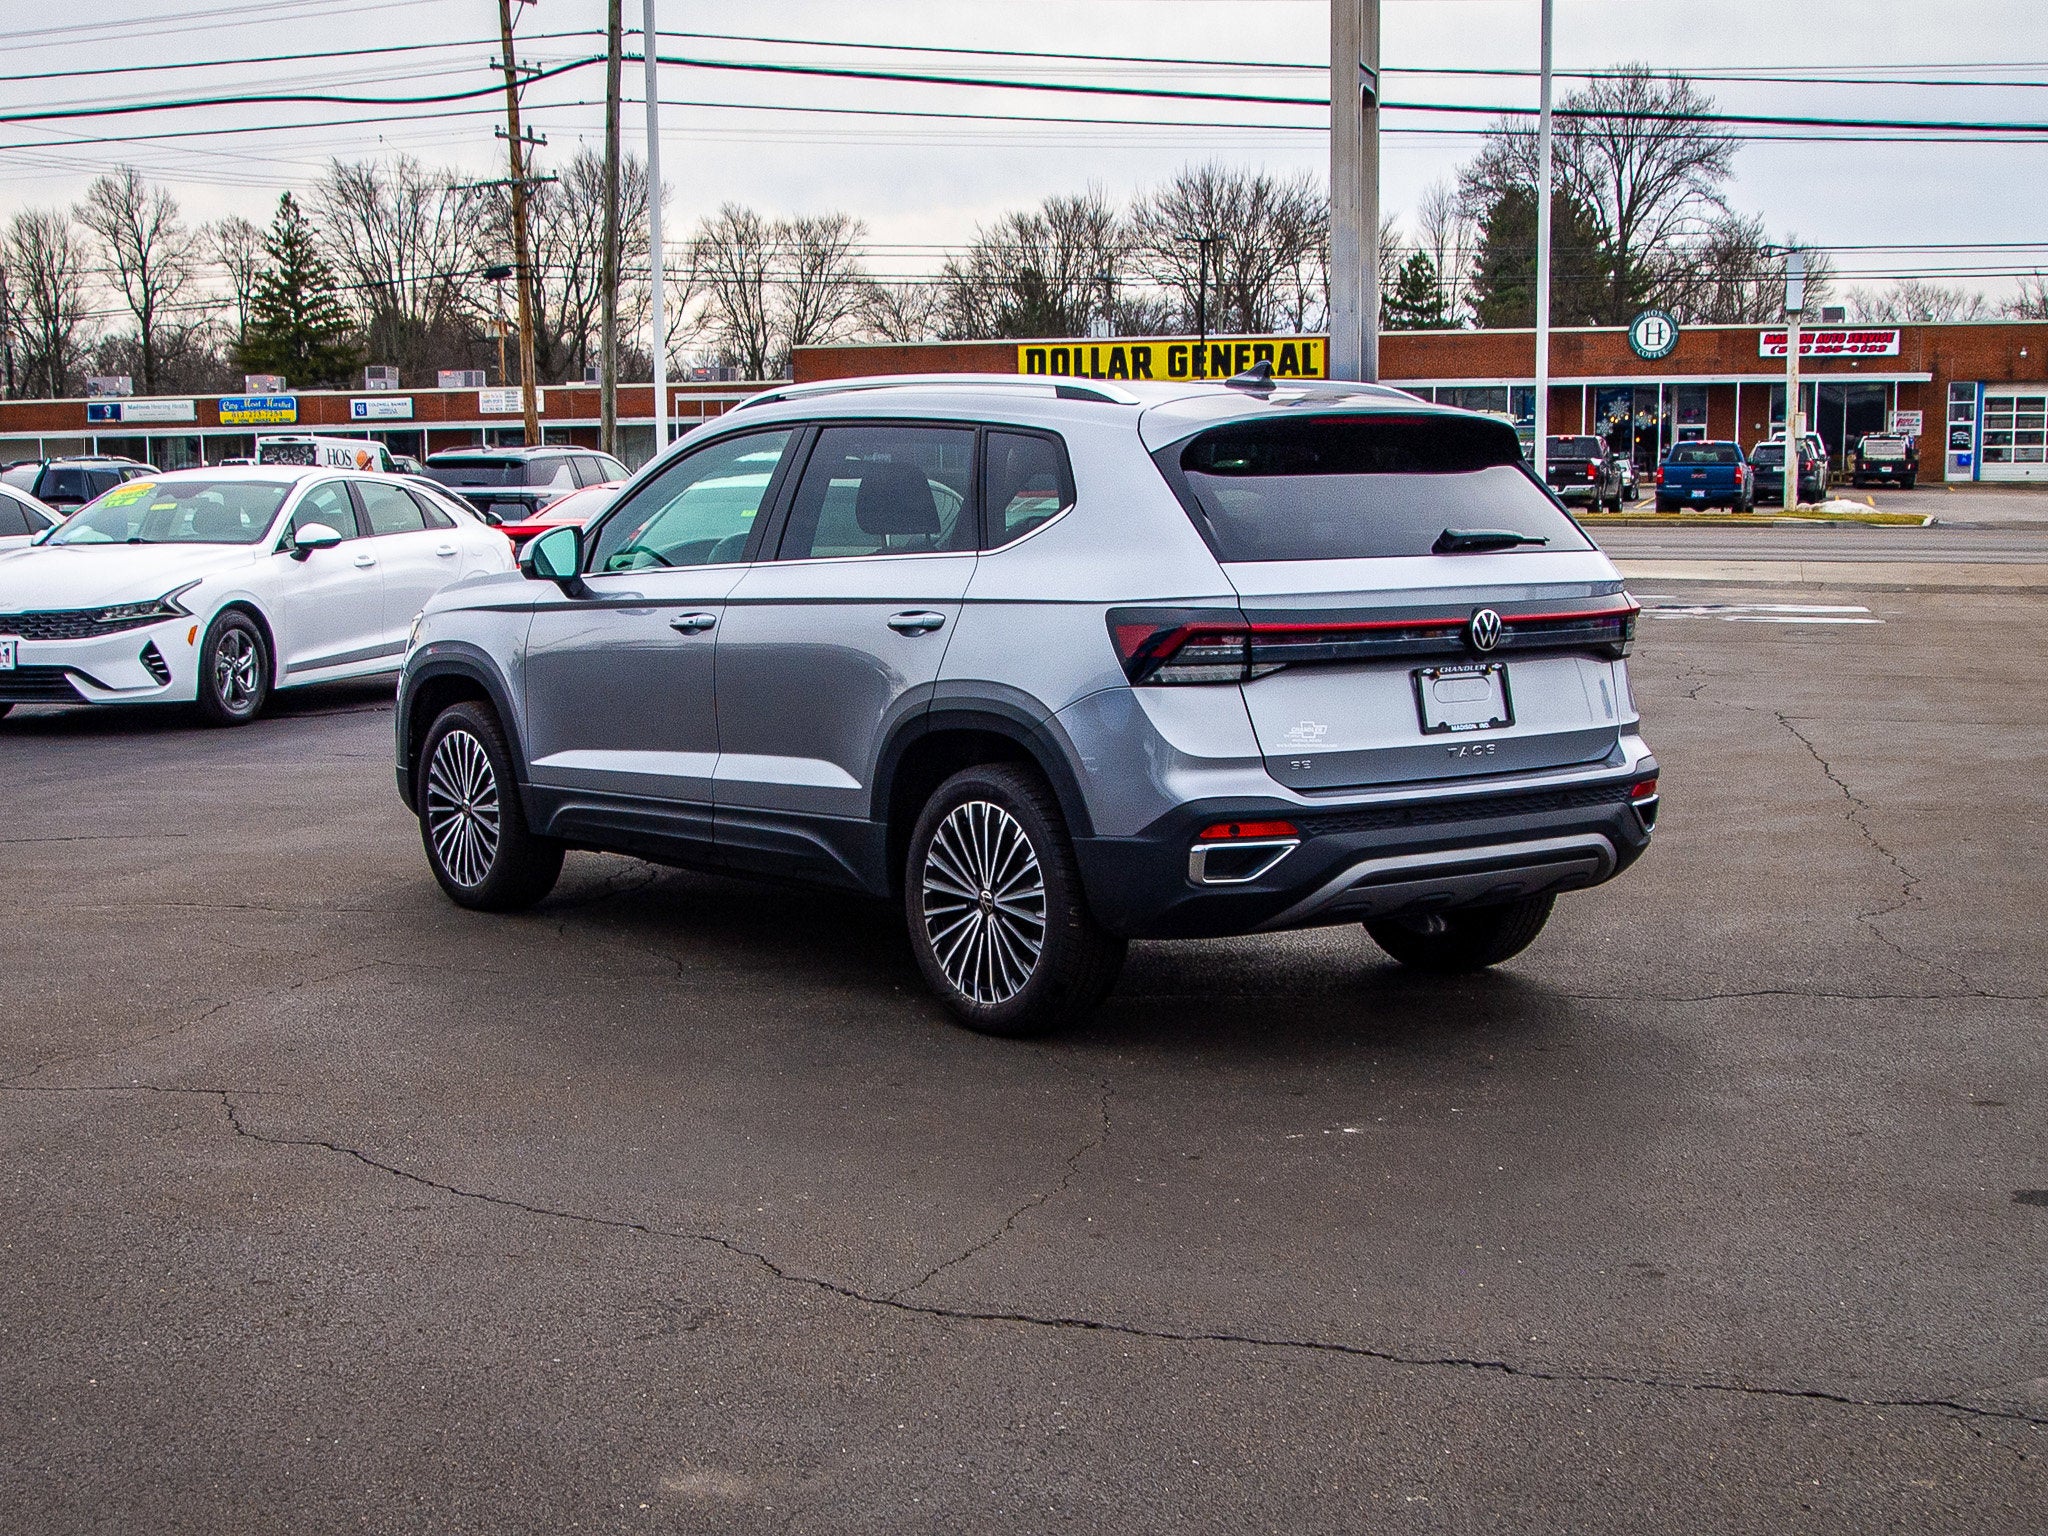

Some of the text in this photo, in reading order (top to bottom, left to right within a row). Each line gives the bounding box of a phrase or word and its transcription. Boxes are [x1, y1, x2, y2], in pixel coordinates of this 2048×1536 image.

[1815, 333, 1847, 344] AUTO
[1846, 332, 1895, 344] SERVICE
[1636, 348, 1669, 359] COFFEE
[1025, 344, 1319, 380] DOLLAR GENERAL
[325, 447, 352, 467] HOS
[1440, 664, 1487, 673] CHANDLER
